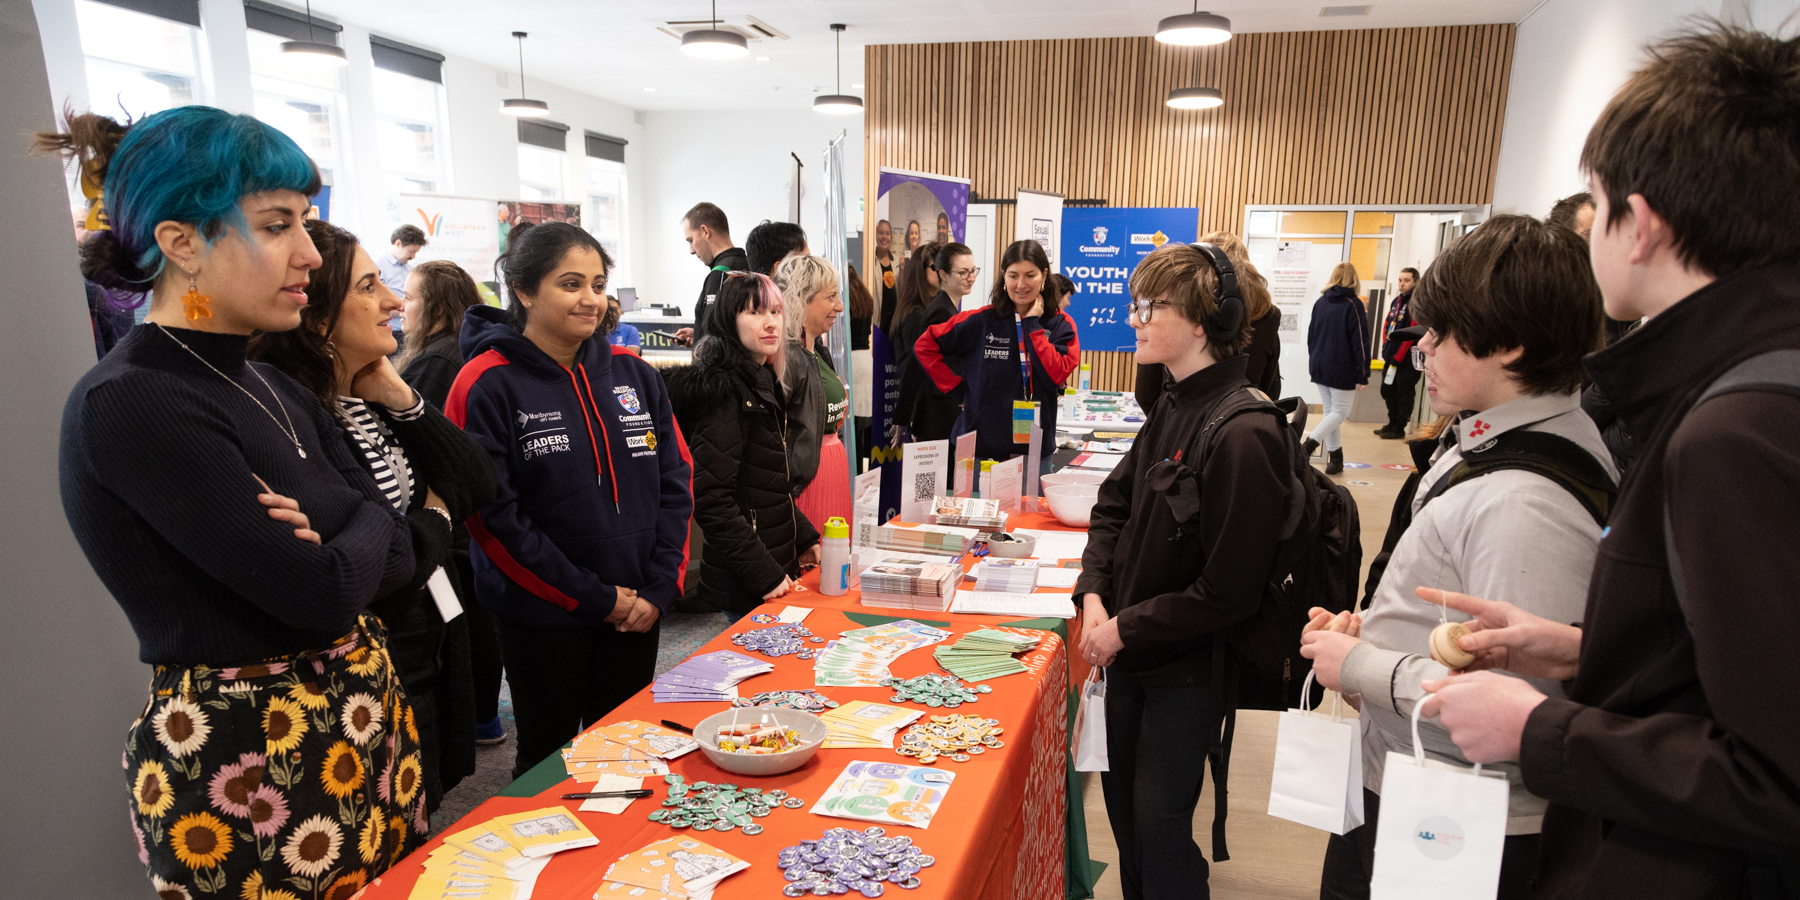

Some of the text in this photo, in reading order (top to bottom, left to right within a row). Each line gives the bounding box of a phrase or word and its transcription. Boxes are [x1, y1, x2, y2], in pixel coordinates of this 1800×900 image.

[444, 223, 486, 231] VOLUNTEER
[1034, 224, 1049, 235] Sexual
[448, 245, 490, 253] Volunteers
[1079, 245, 1120, 255] Community
[1065, 266, 1128, 279] YOUTH
[1086, 282, 1124, 294] THE
[884, 378, 900, 389] pow
[884, 390, 900, 399] entr
[884, 403, 893, 412] to
[827, 414, 835, 423] in
[522, 434, 570, 453] LEADERS
[524, 443, 571, 461] OF THE PACK
